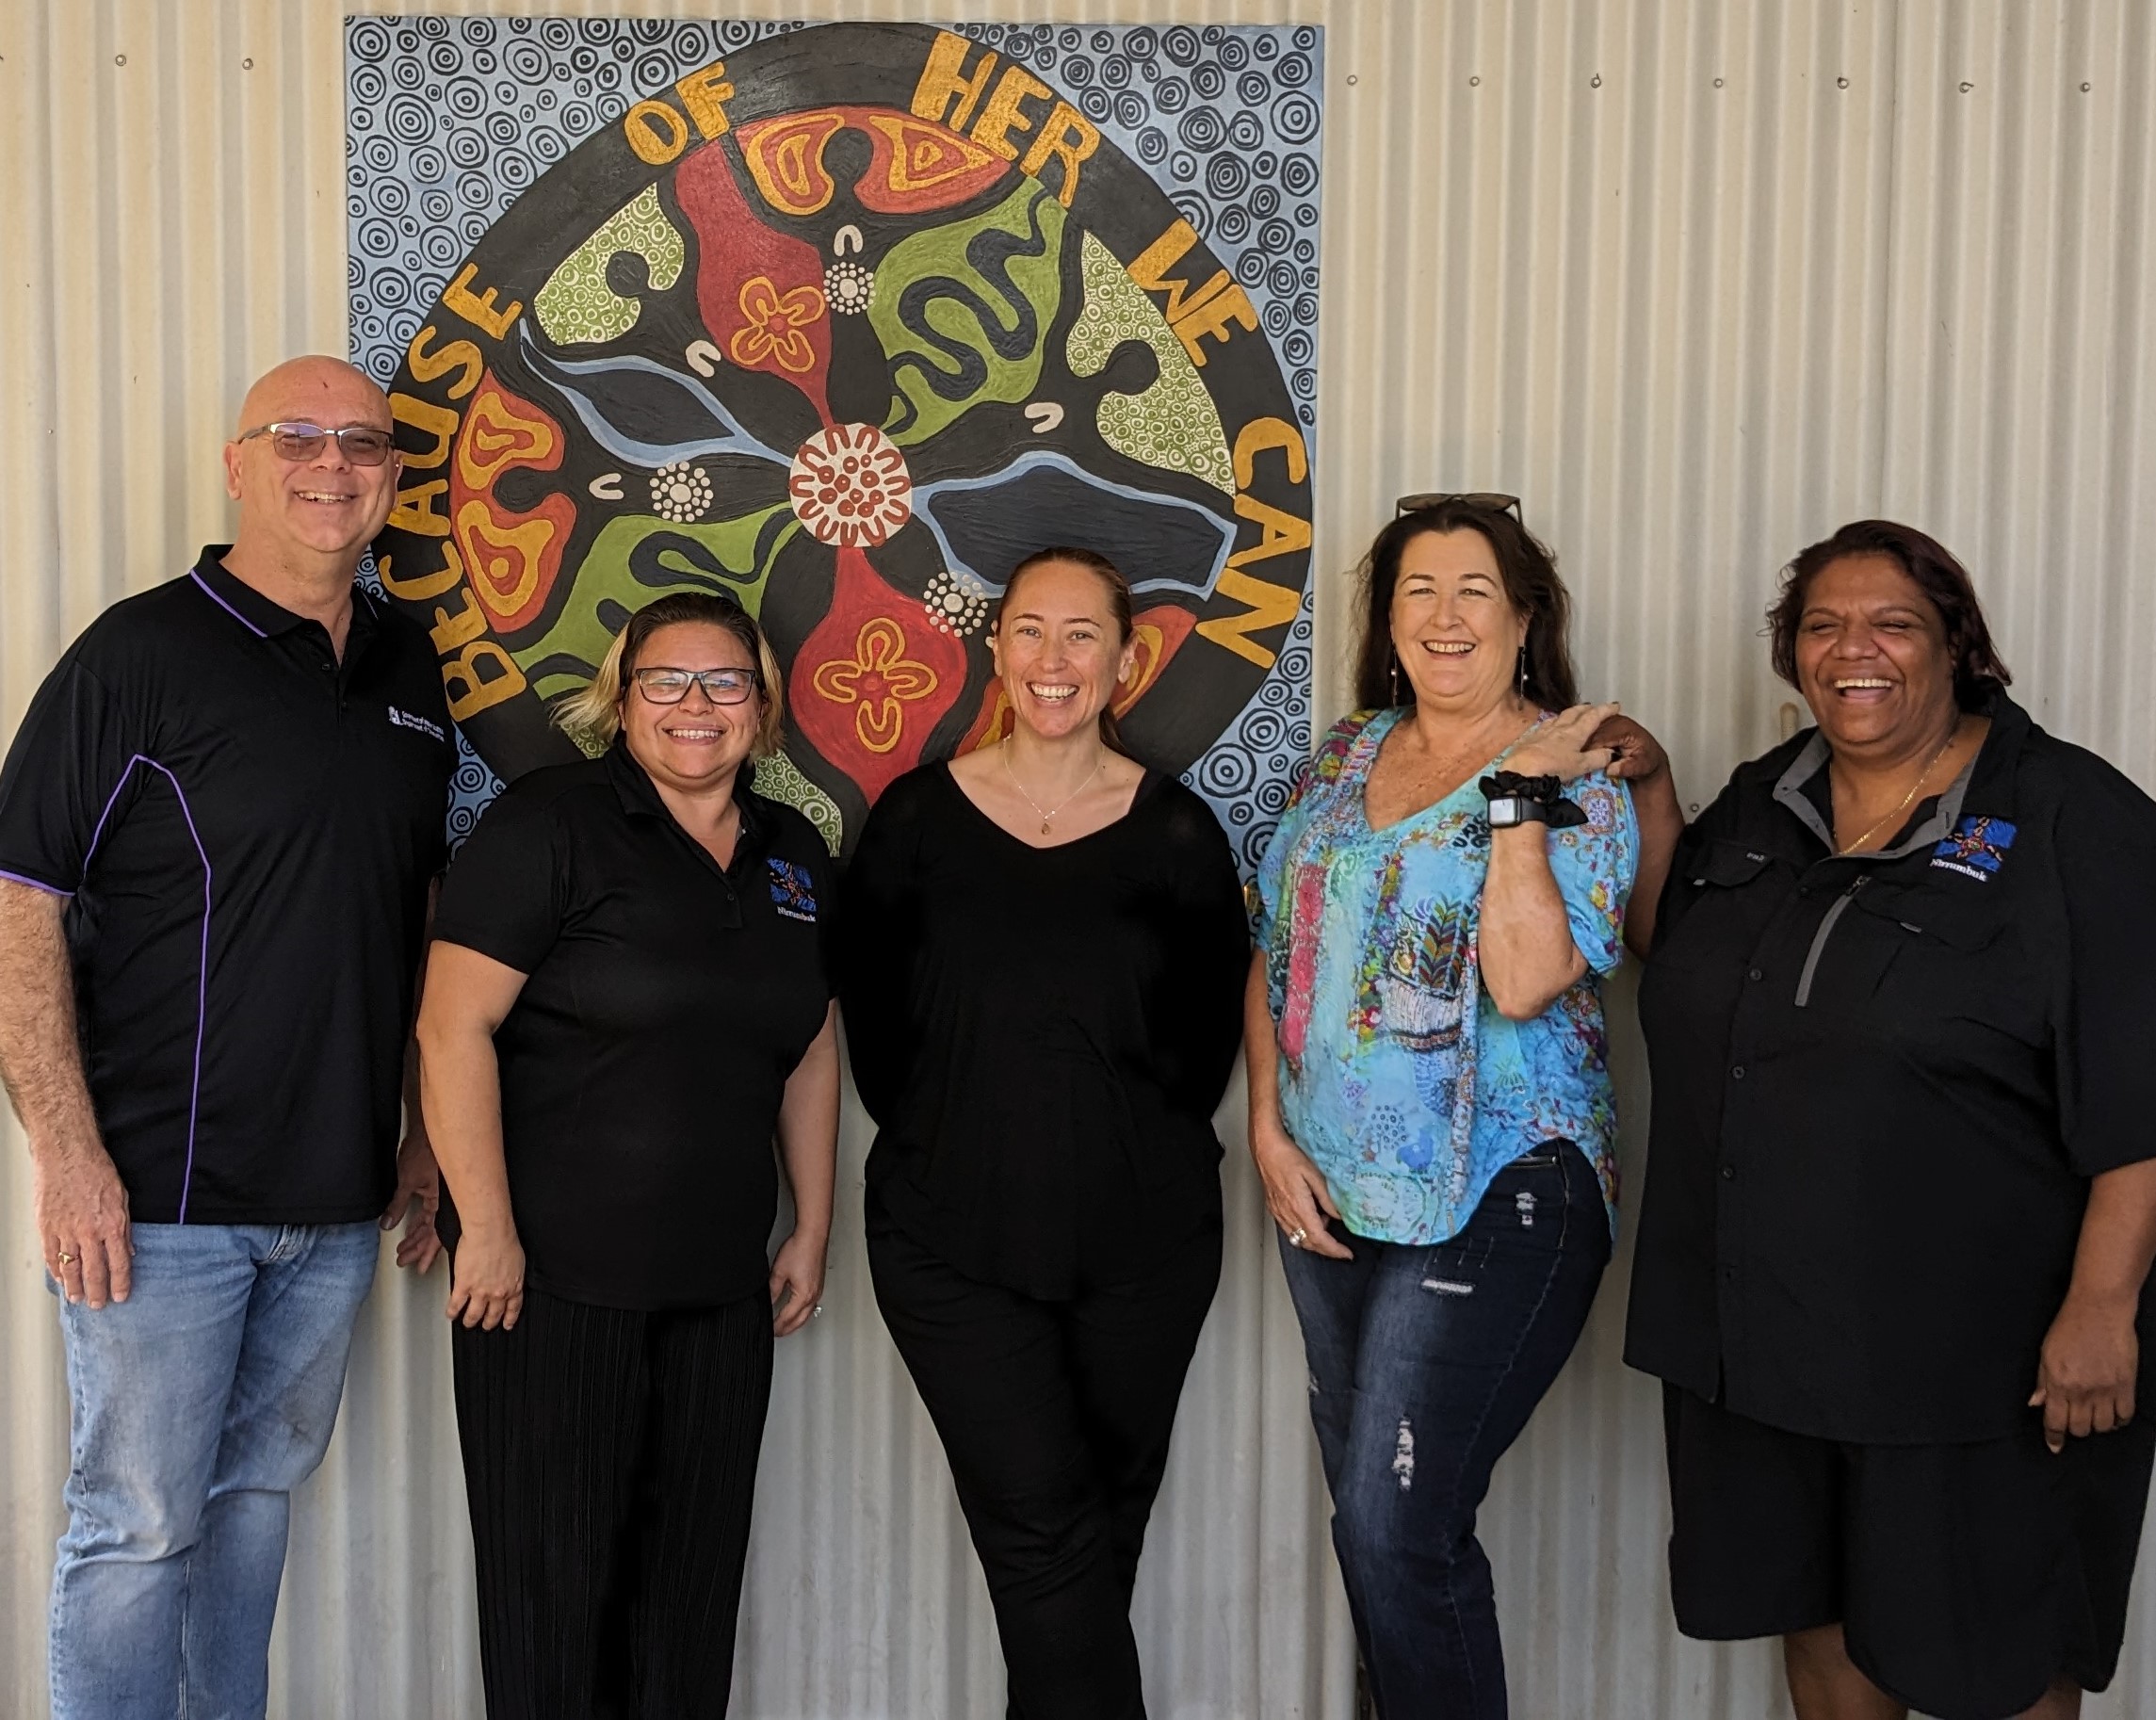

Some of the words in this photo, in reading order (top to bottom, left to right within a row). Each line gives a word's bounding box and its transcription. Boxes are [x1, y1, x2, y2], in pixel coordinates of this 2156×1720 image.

[379, 263, 527, 722] BECAUSE
[624, 61, 735, 166] OF
[910, 30, 1101, 208] HER
[1127, 218, 1258, 367] WE
[1195, 416, 1312, 670] CAN
